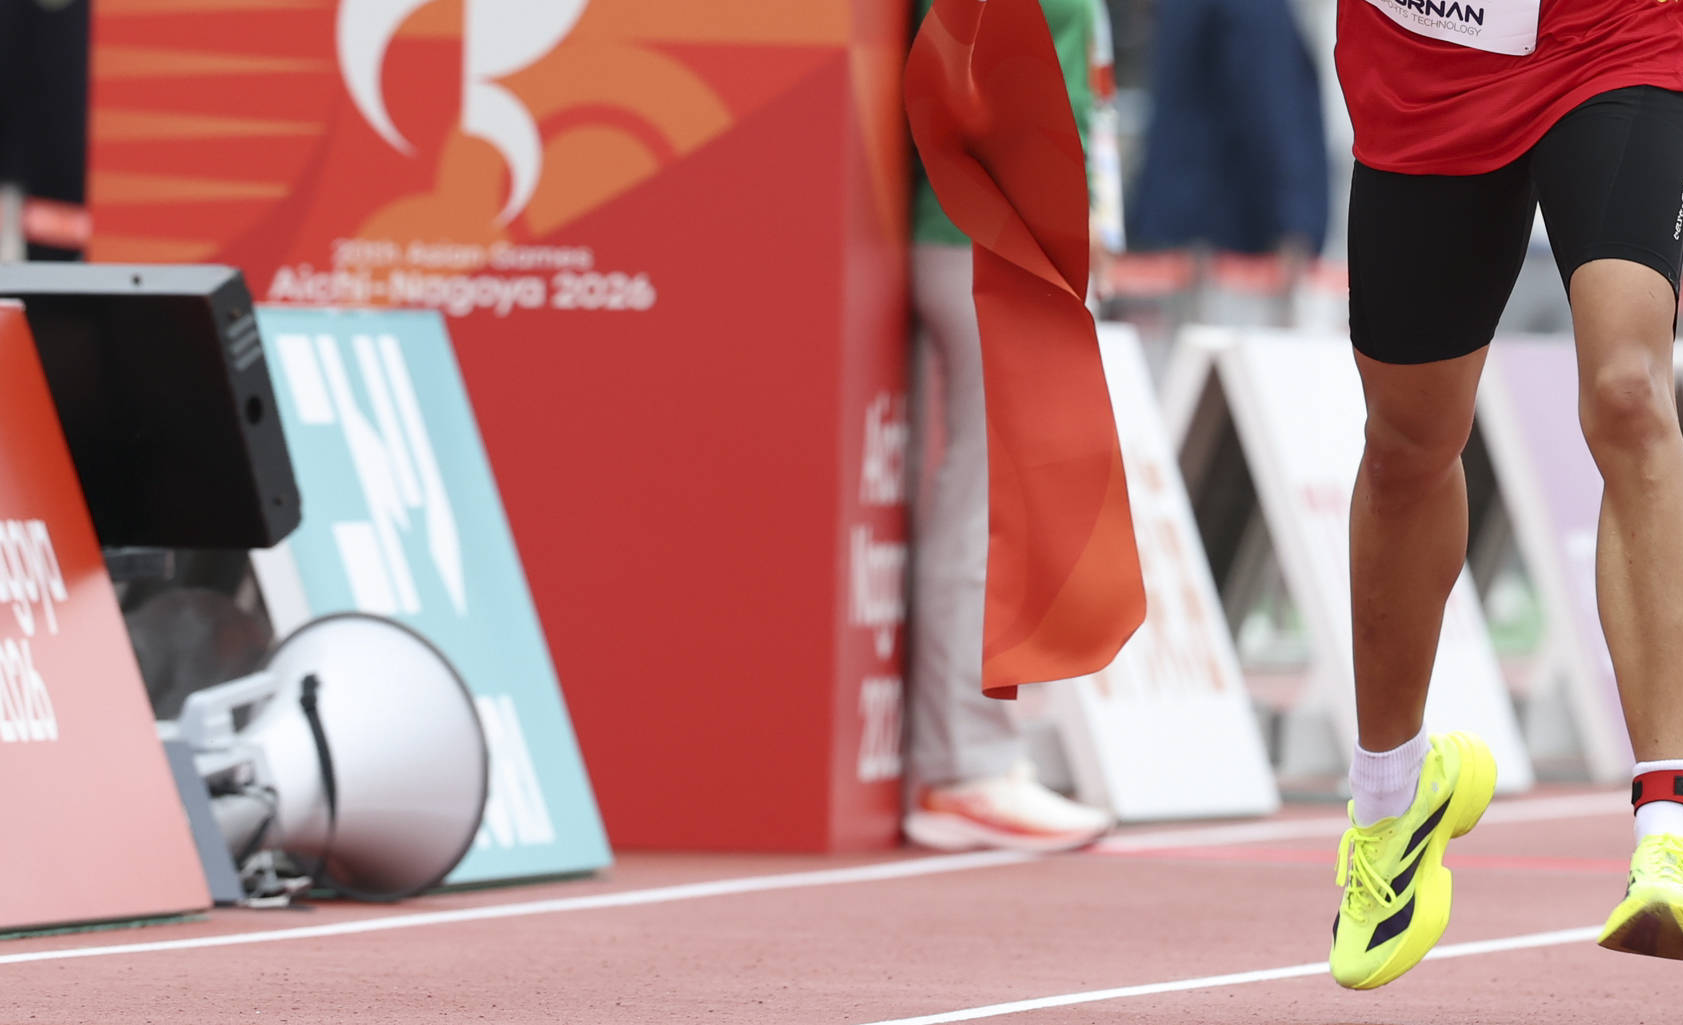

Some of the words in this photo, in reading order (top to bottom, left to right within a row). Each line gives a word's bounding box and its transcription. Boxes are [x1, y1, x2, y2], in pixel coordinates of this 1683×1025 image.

[1411, 13, 1482, 37] TECHNOLOGY
[405, 240, 486, 270] Asian
[489, 241, 594, 271] Games
[267, 263, 546, 317] Aichi-Nagoya
[551, 271, 656, 311] 2026
